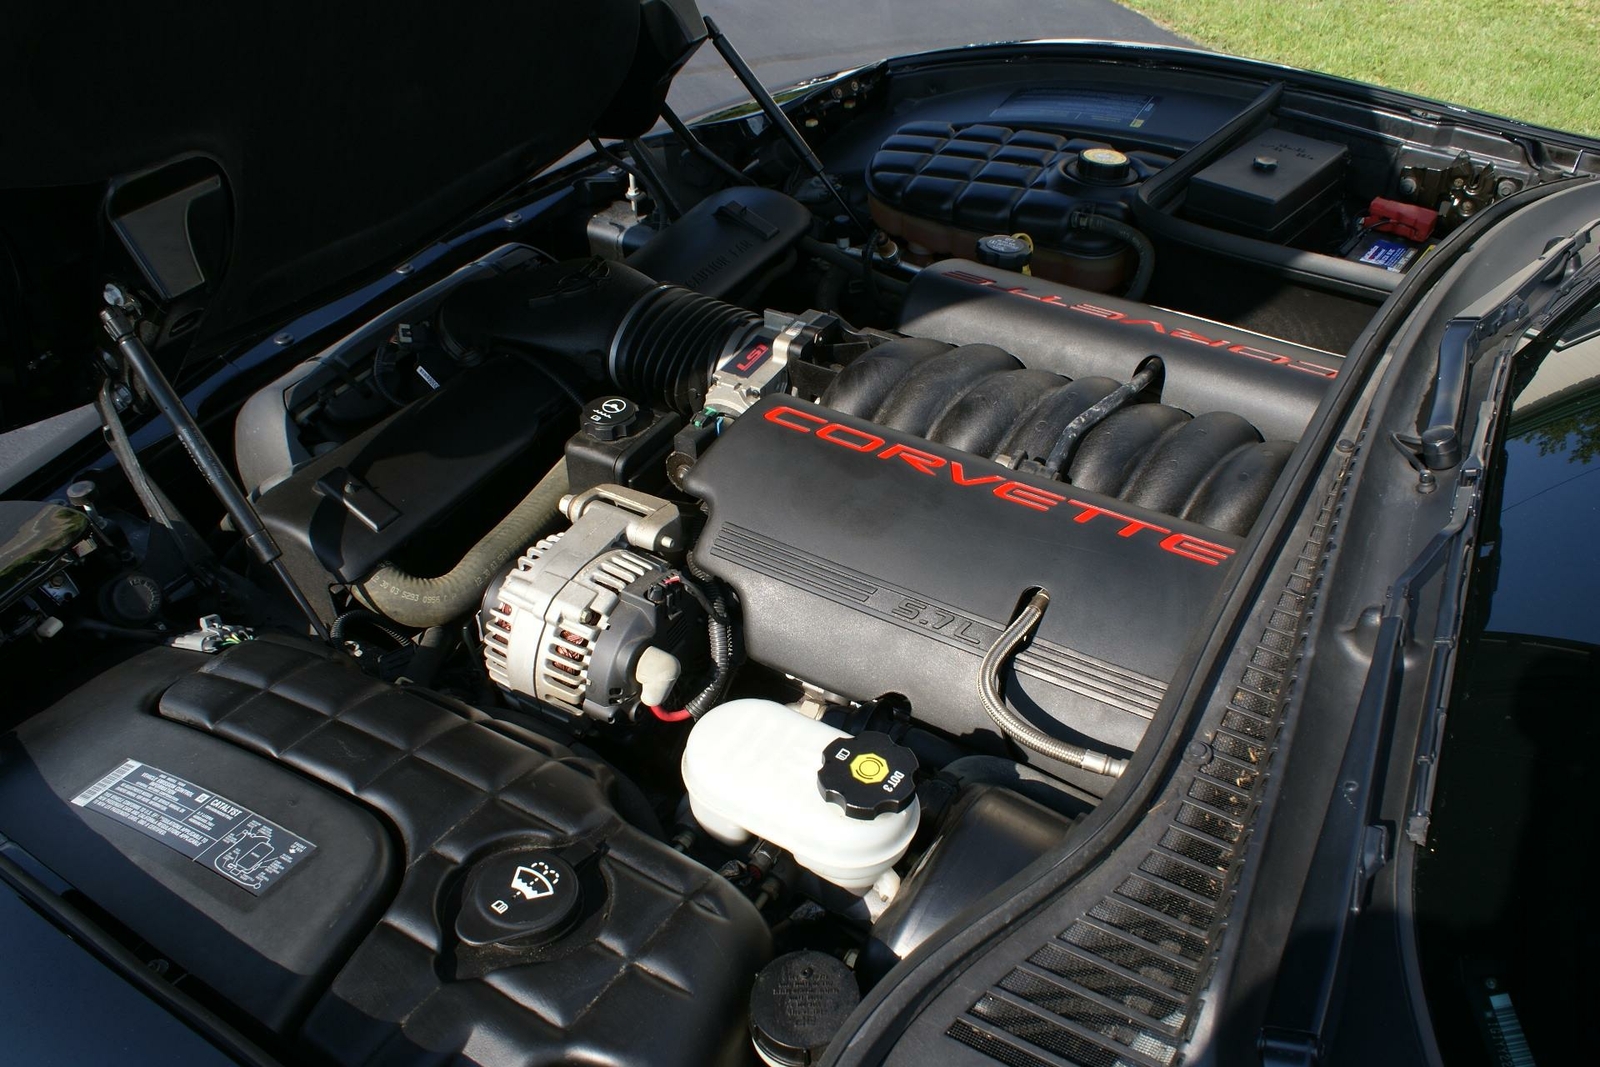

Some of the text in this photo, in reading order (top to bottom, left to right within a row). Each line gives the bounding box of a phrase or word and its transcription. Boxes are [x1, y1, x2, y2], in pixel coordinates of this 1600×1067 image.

[941, 270, 1339, 378] CORVETTE
[763, 406, 1236, 565] CORVETTE
[891, 598, 980, 644] 5.7L
[882, 770, 905, 792] DOT 3
[210, 799, 243, 817] CATALYST
